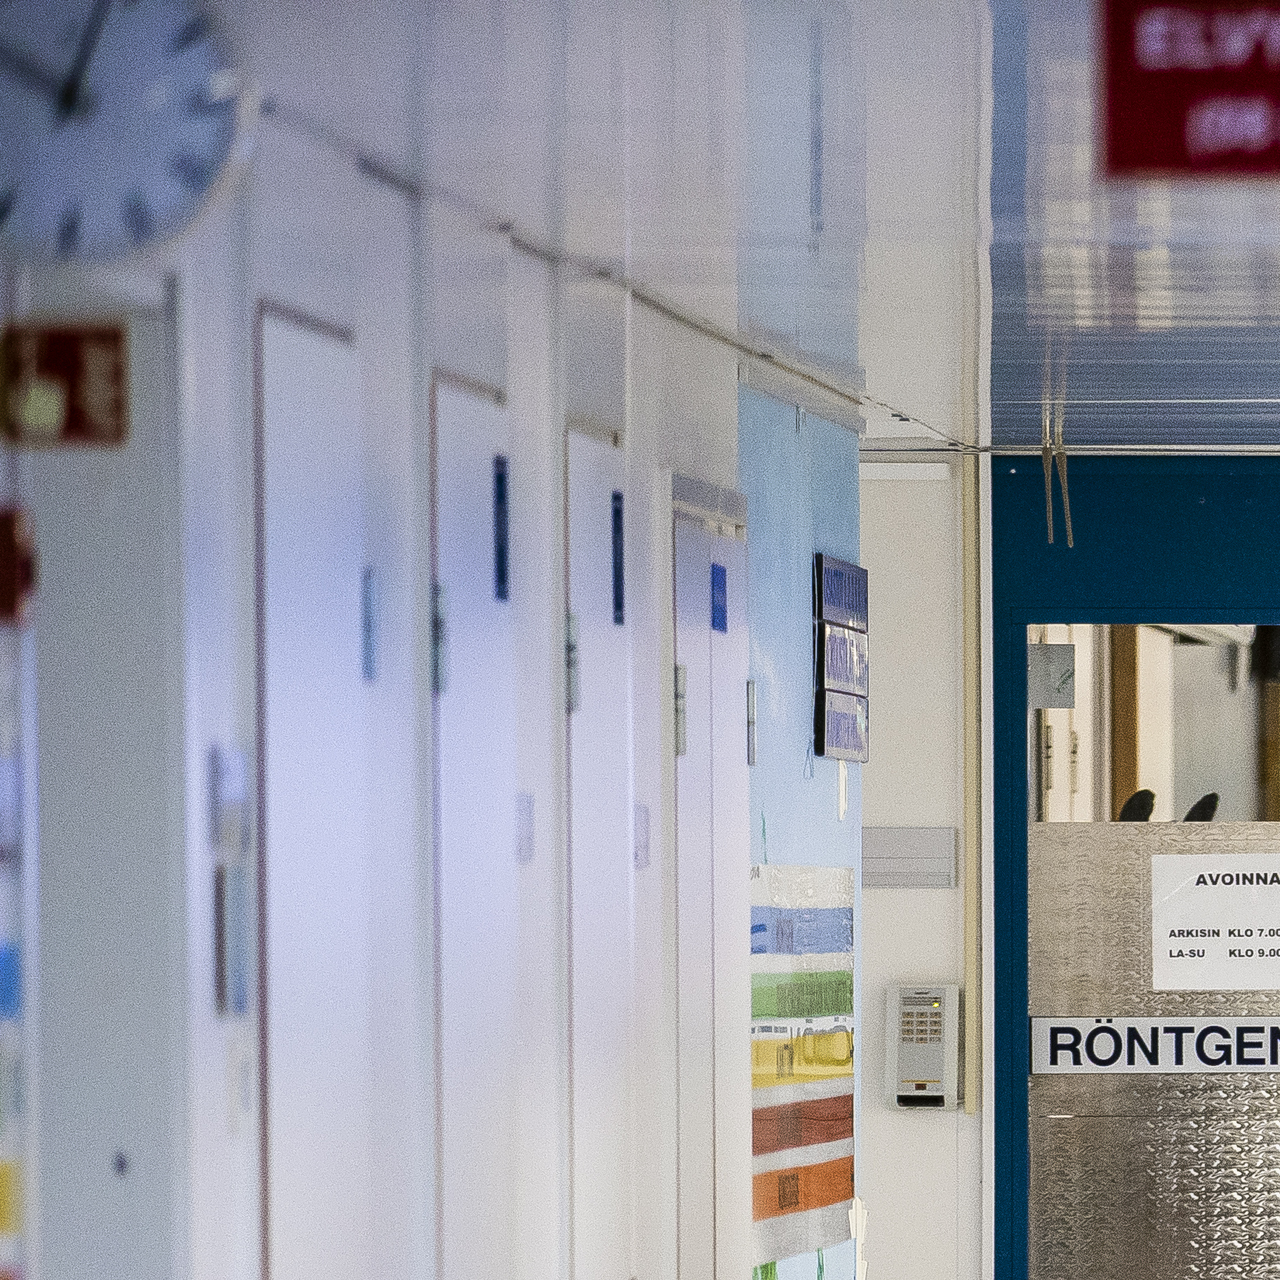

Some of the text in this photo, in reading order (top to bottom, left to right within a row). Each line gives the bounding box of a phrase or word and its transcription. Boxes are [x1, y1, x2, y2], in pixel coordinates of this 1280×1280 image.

[1168, 928, 1221, 938] ARKISIN
[1228, 928, 1253, 938] KLO
[1169, 948, 1205, 958] LA-SU
[1228, 948, 1253, 958] KLO
